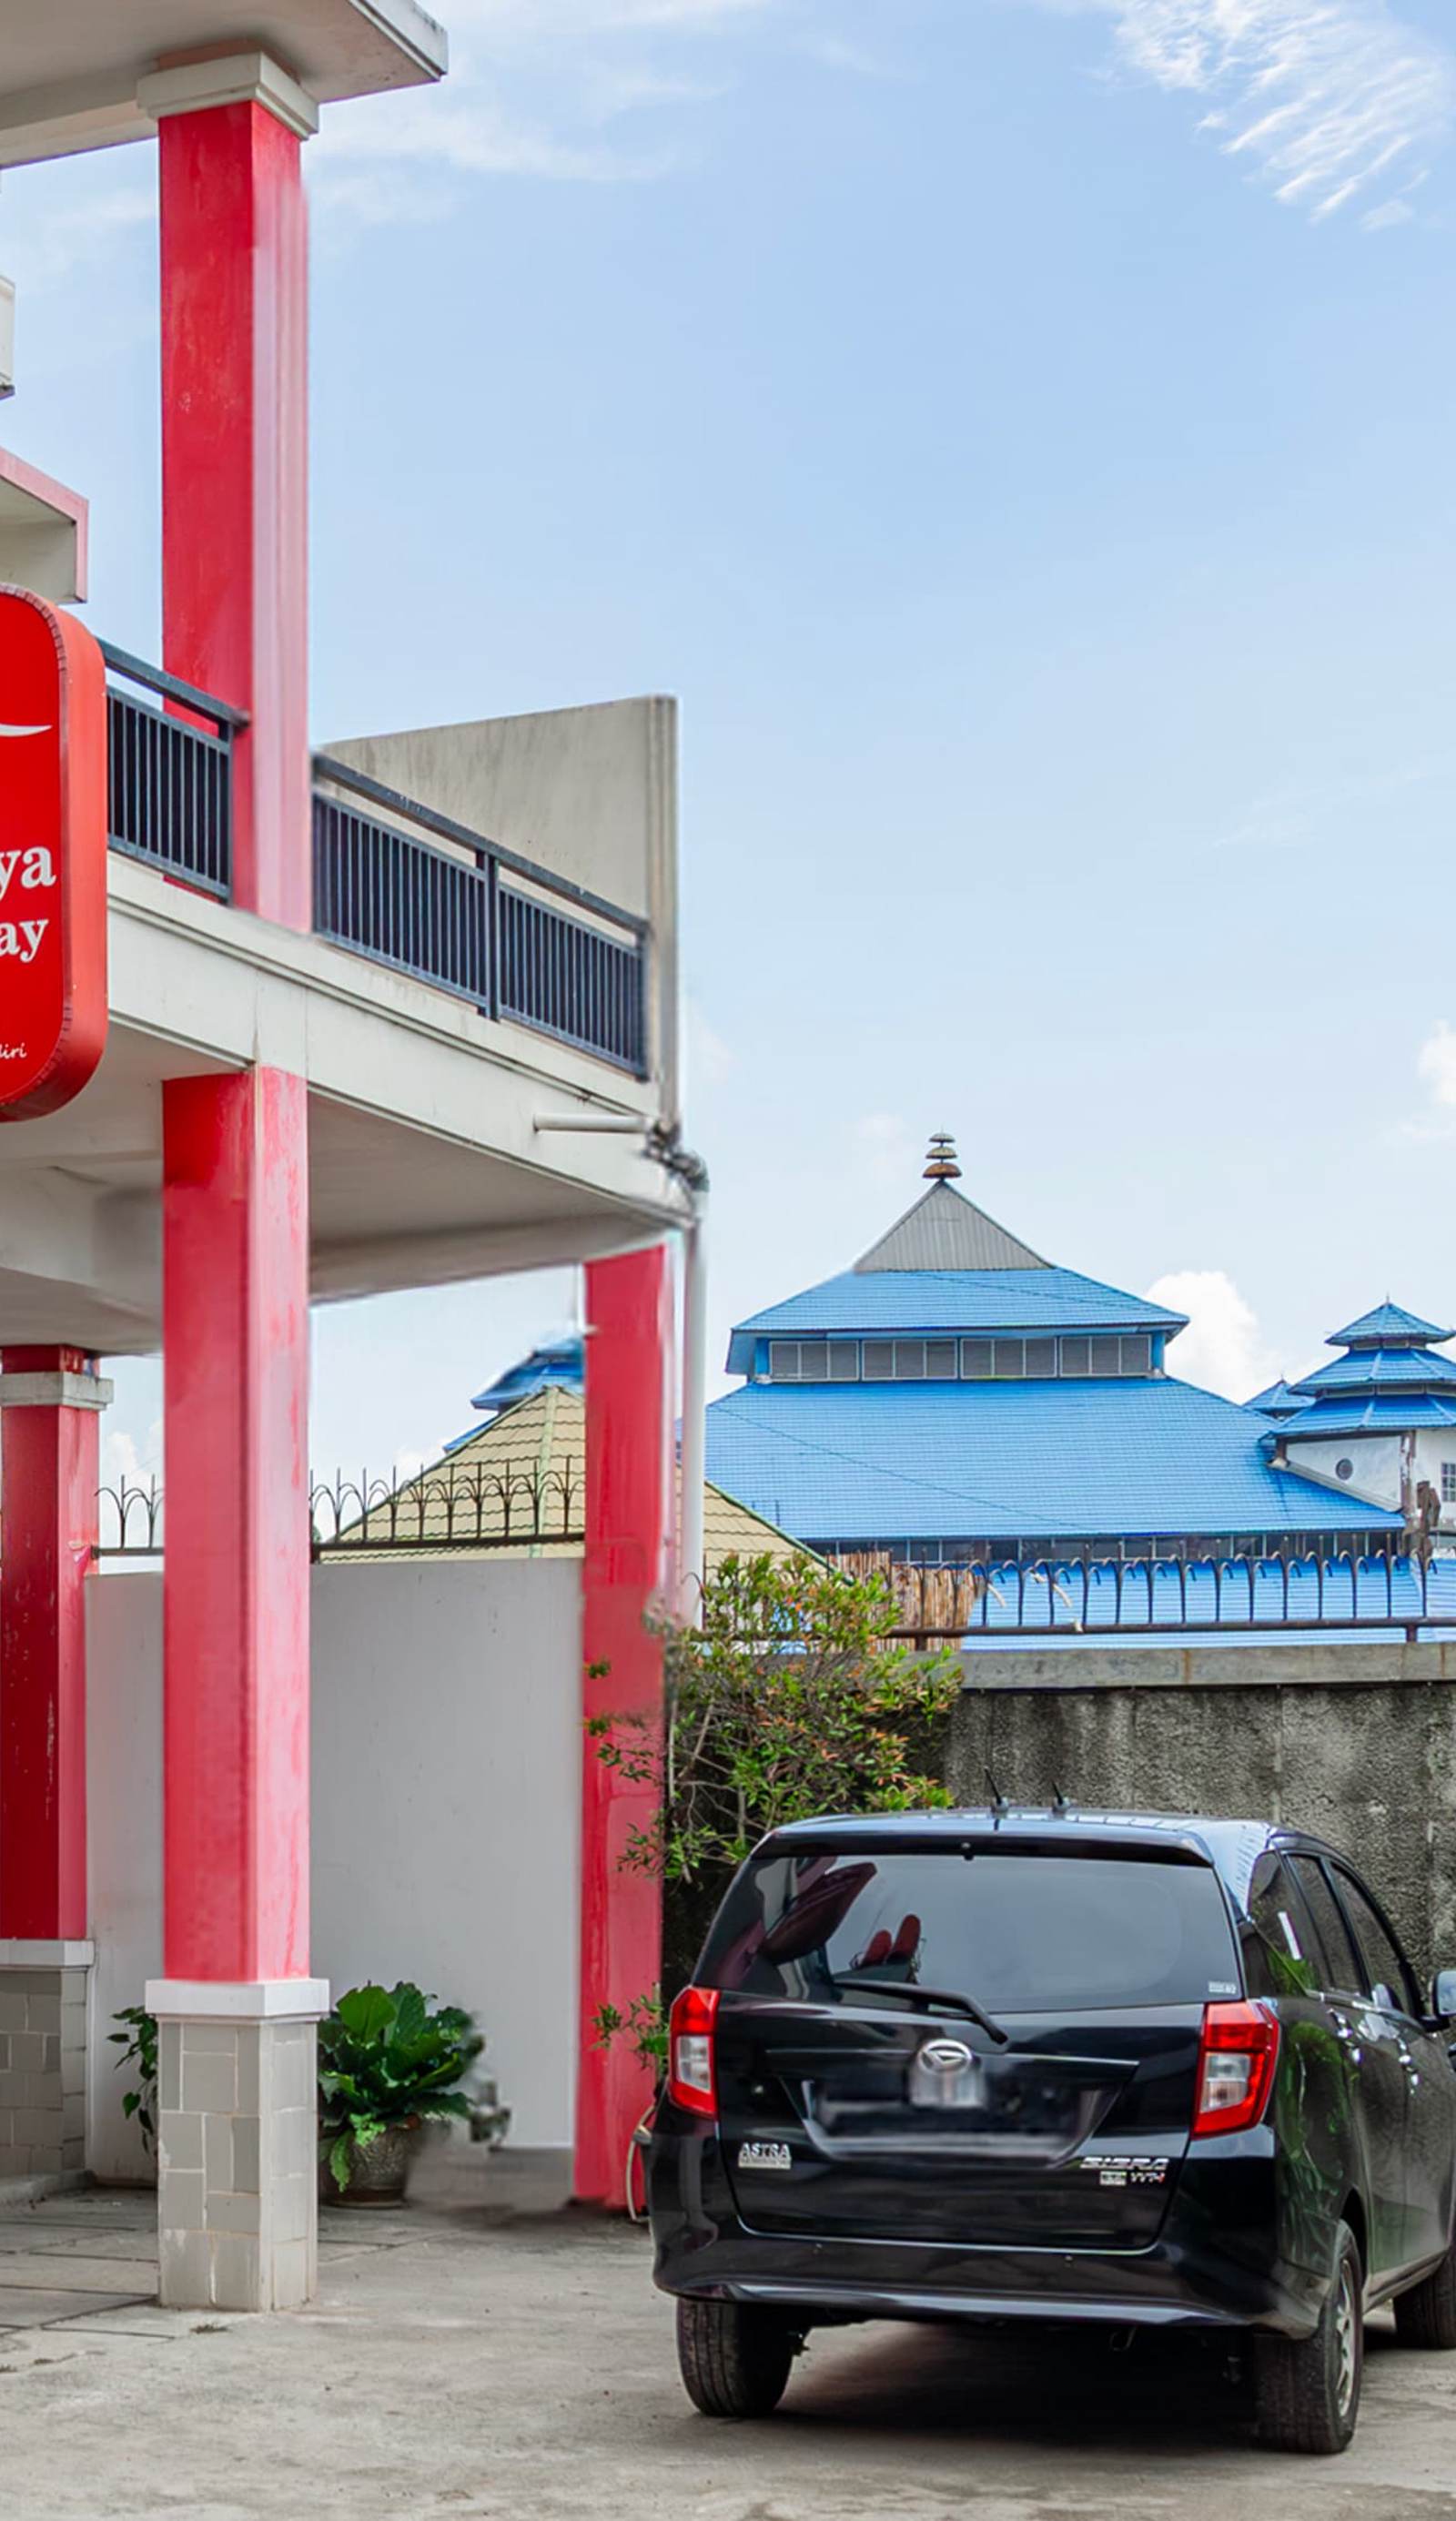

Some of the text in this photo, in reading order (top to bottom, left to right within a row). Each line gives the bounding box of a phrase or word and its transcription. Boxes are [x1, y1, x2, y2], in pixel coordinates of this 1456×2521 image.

[0, 846, 56, 901] ya
[0, 919, 49, 963] ay
[739, 2141, 792, 2159] ASTRA
